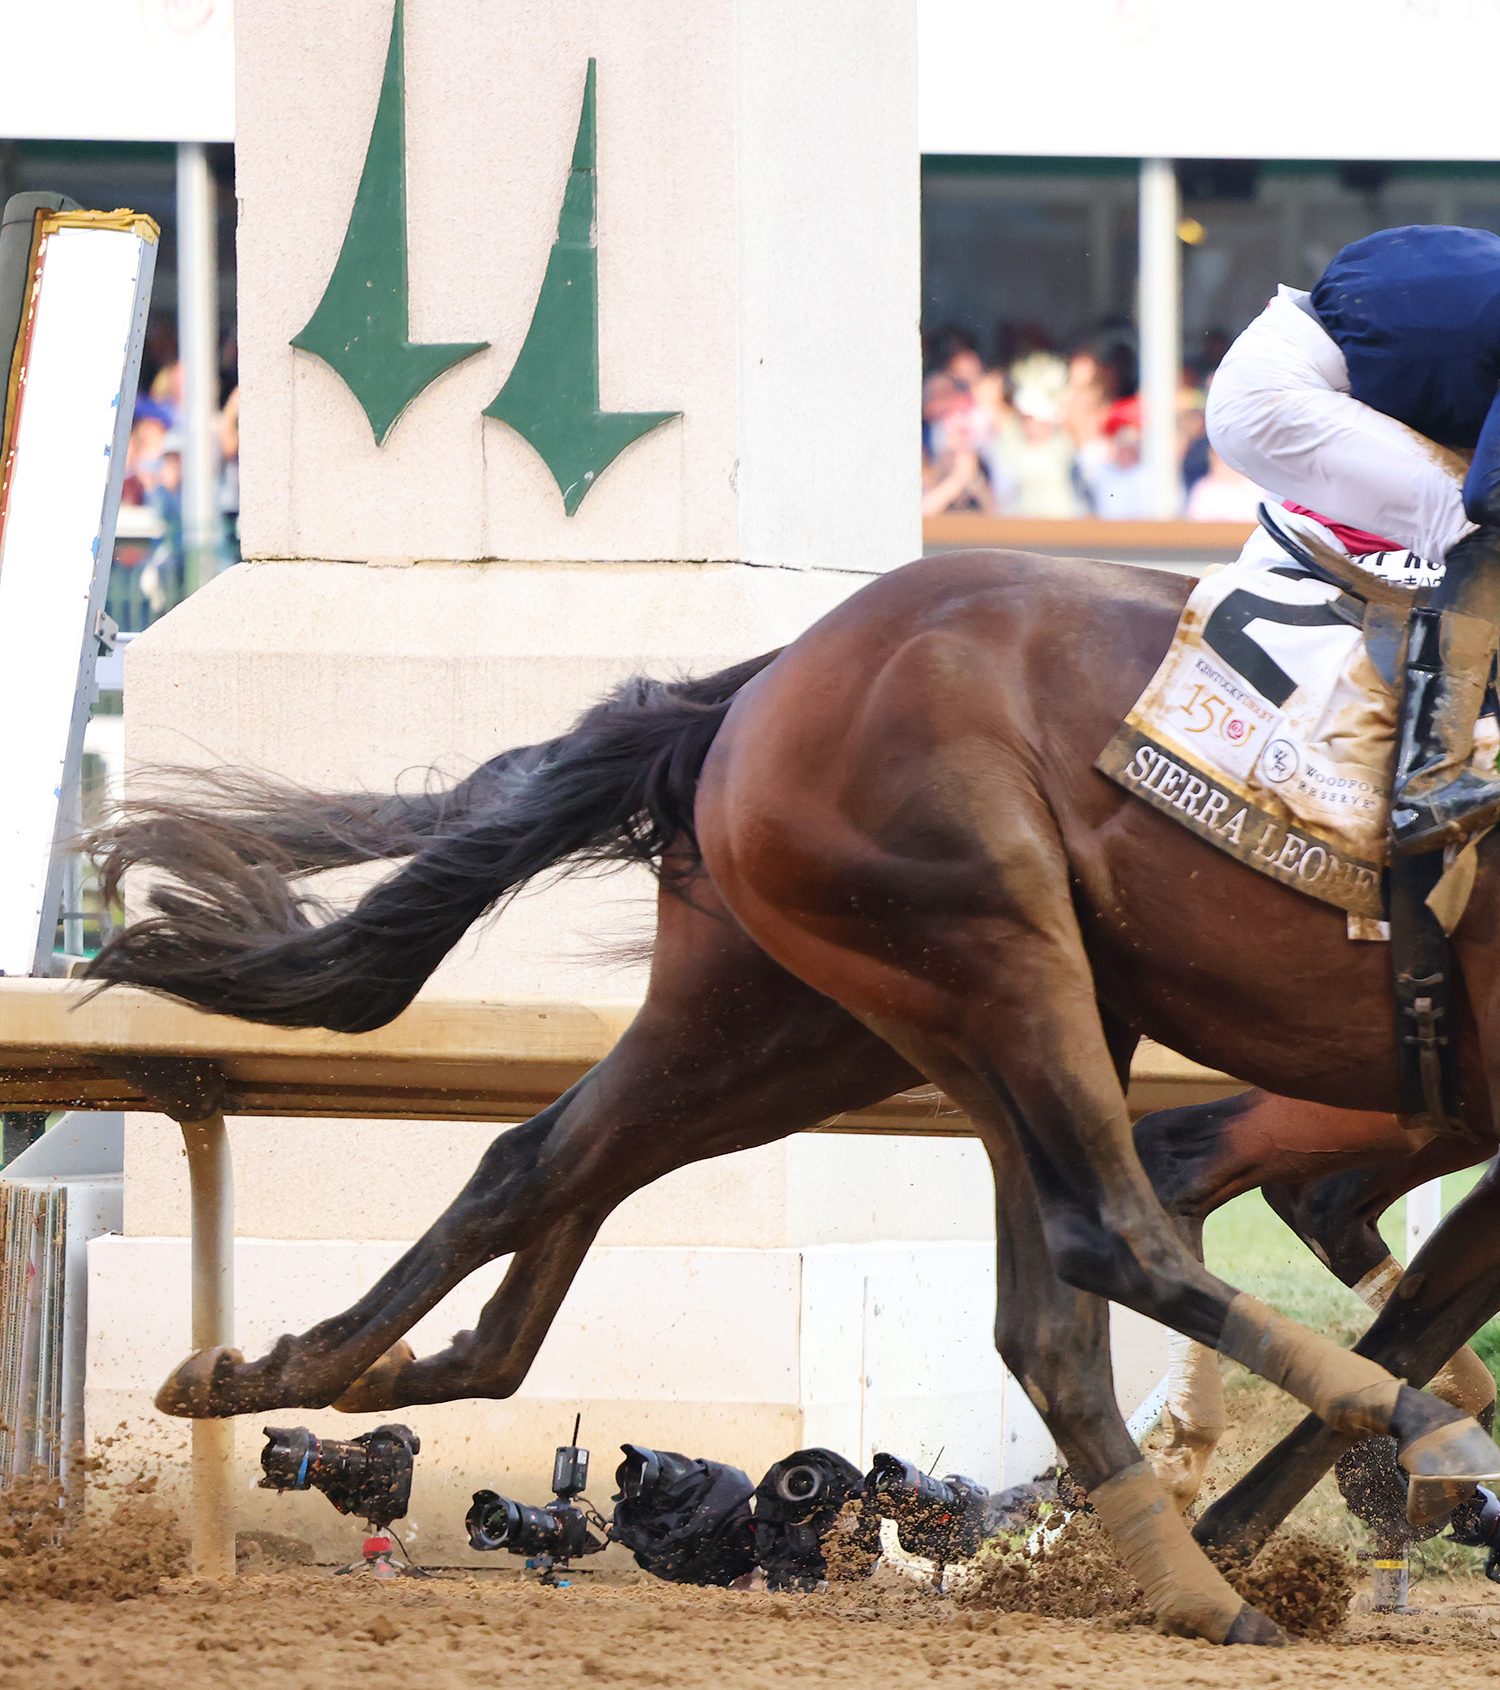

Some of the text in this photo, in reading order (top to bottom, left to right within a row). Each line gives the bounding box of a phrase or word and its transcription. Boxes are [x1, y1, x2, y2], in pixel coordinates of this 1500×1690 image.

[1202, 588, 1363, 708] 2
[1124, 745, 1379, 883] SIERRA LEONE
